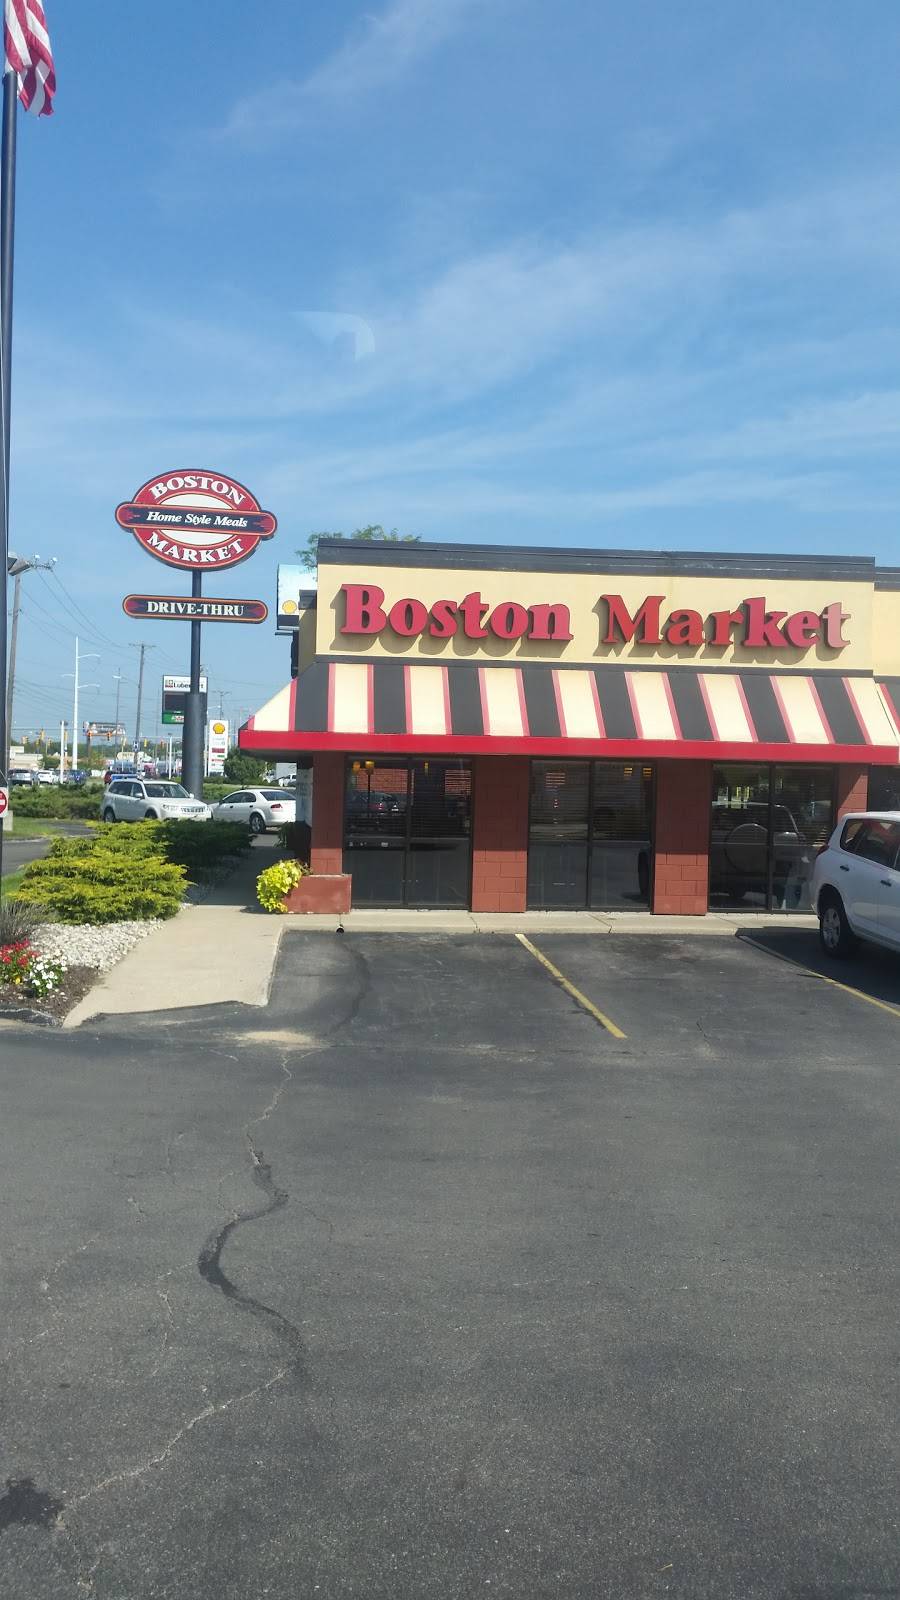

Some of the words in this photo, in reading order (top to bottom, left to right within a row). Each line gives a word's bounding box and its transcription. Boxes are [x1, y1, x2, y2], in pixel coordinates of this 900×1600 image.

[148, 475, 247, 505] BOSTON
[146, 511, 182, 523] Home
[184, 513, 212, 526] Style
[213, 515, 248, 528] Meals
[146, 532, 245, 563] MARKET
[146, 601, 245, 617] DRIVE-THRU
[340, 583, 574, 642] Boston
[599, 594, 851, 649] Market
